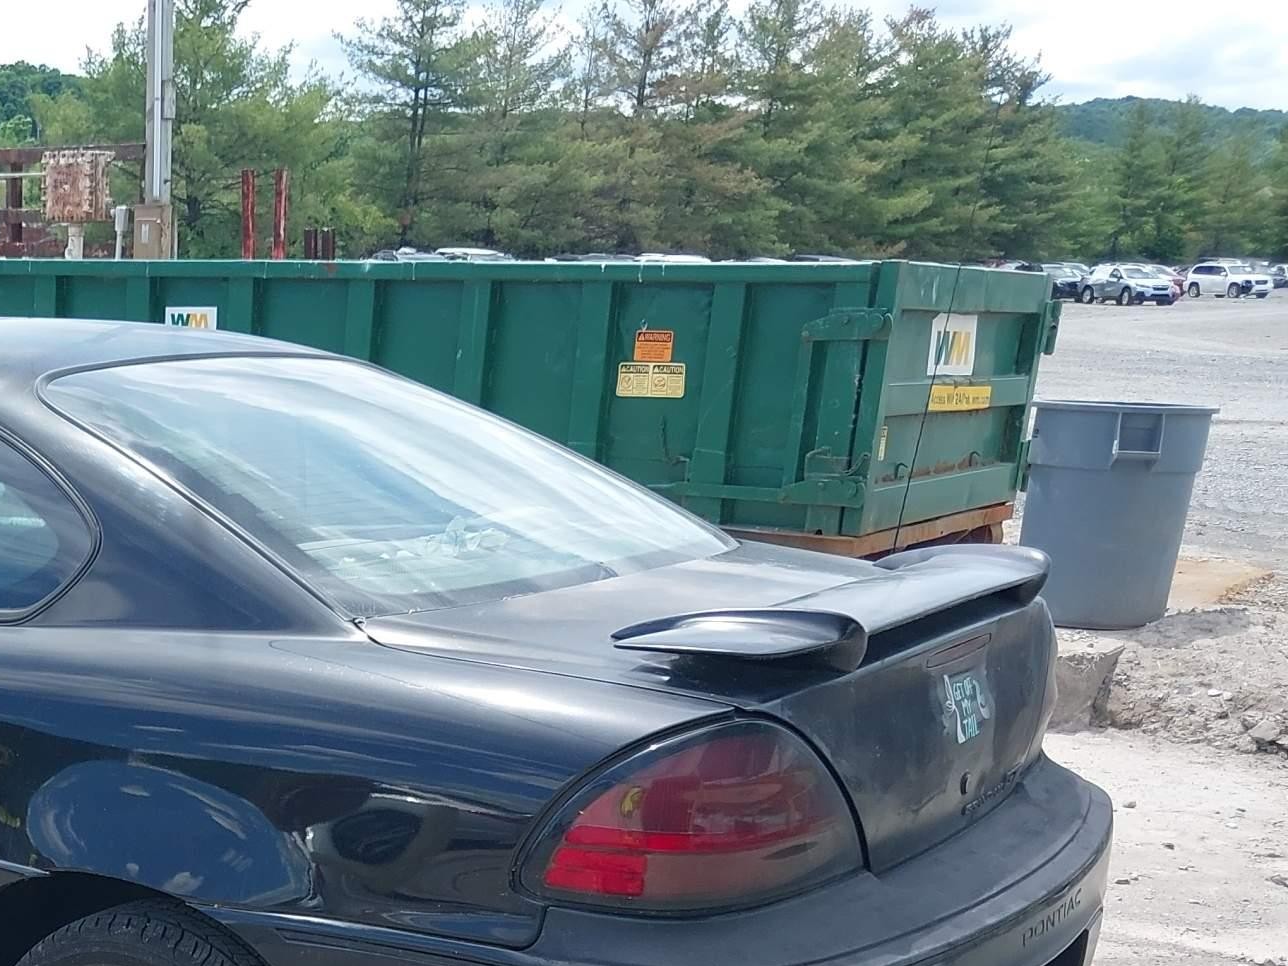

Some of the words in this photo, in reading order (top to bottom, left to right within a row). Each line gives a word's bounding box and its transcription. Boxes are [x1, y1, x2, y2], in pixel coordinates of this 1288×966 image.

[170, 312, 209, 328] WM
[644, 333, 671, 342] WARNING
[933, 331, 972, 366] WM
[658, 366, 684, 374] CAUTION
[953, 682, 965, 700] GET
[961, 698, 972, 717] MY
[962, 713, 980, 740] TAIL
[1022, 887, 1082, 948] PONTIAC
